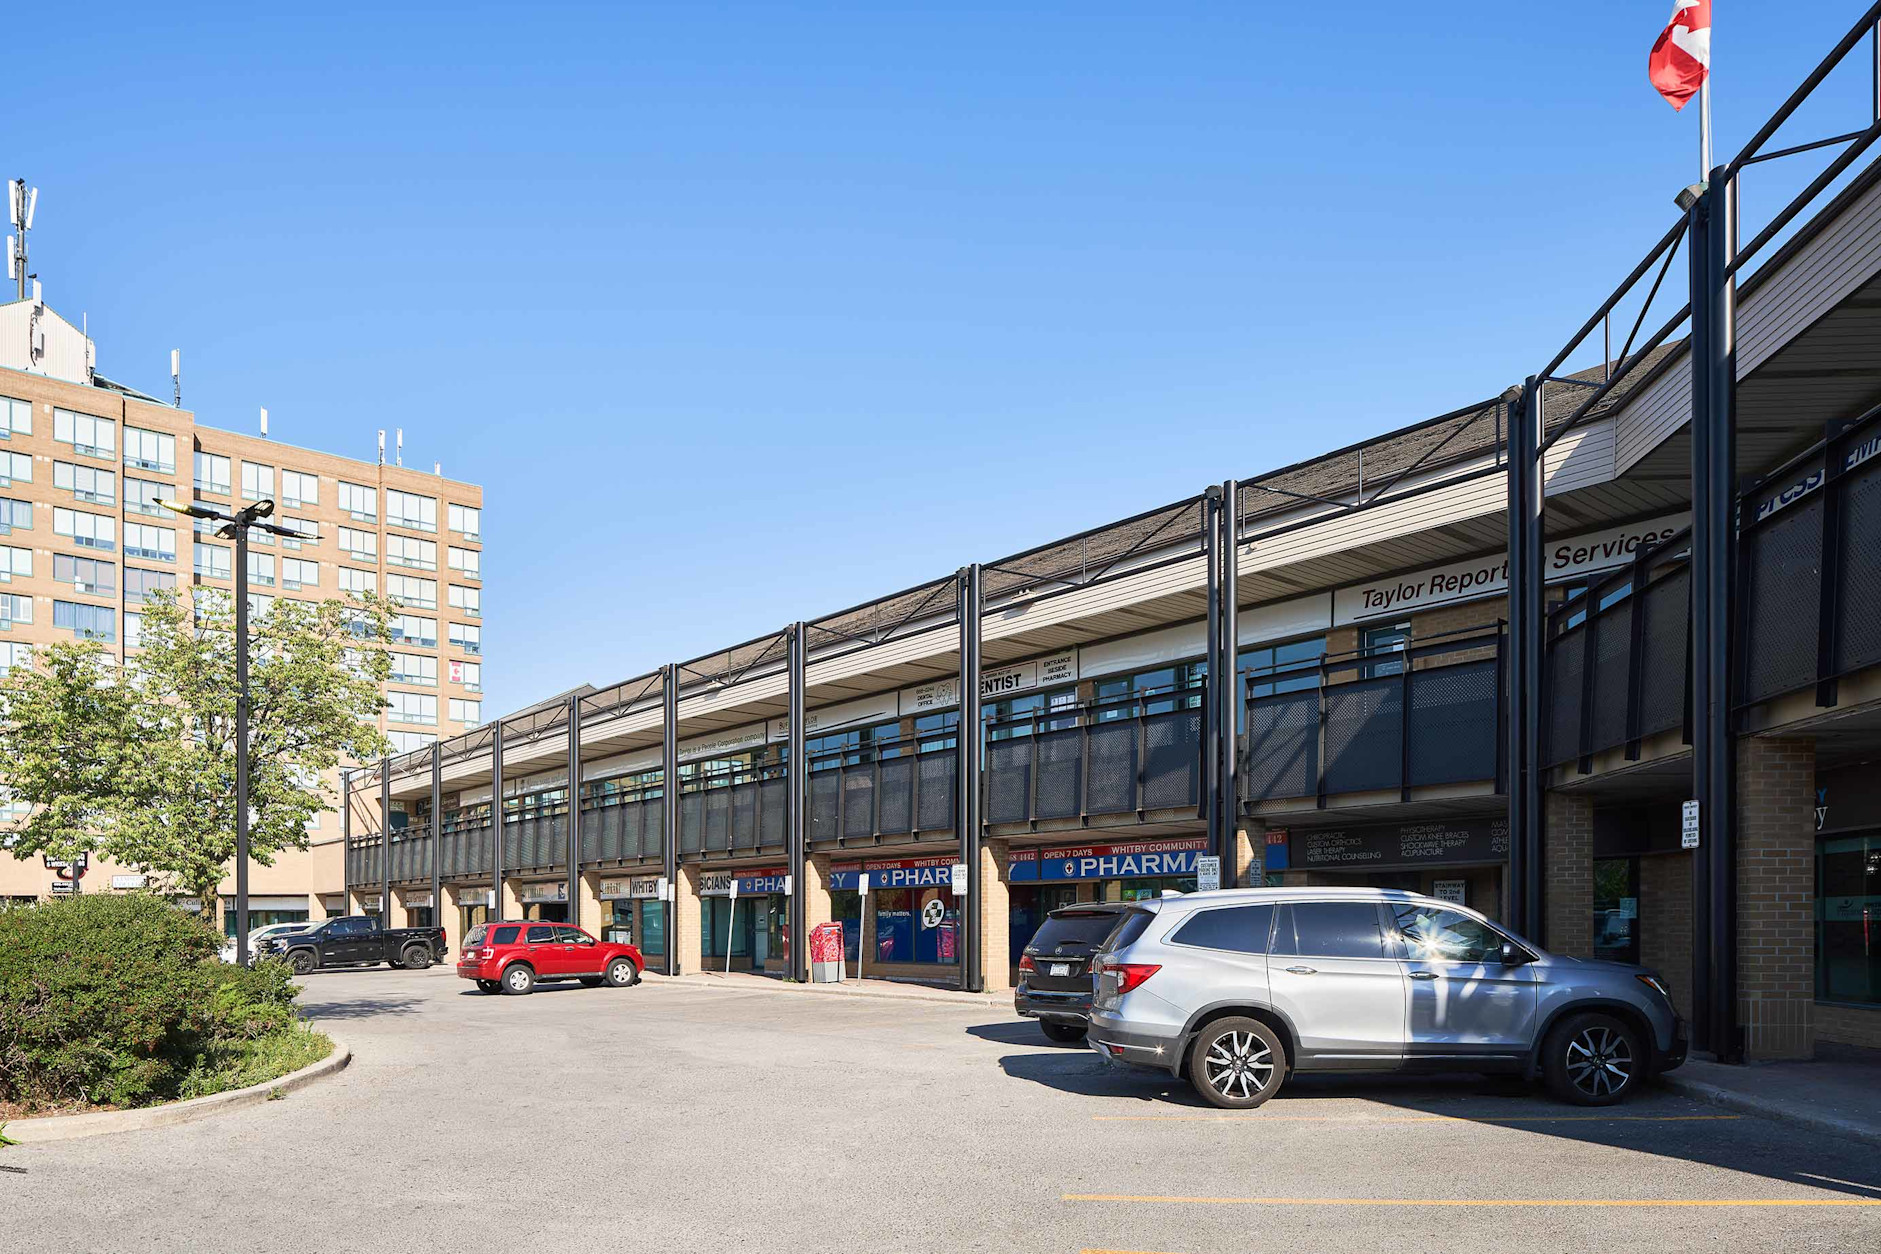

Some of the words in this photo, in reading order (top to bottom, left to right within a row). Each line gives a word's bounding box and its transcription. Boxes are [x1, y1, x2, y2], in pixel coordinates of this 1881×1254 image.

[1362, 581, 1425, 609] Taylor
[1429, 560, 1509, 597] Report
[1043, 656, 1072, 668] ENTRANCE
[1047, 664, 1067, 674] BESIDE
[1042, 671, 1072, 683] PHARMACY
[980, 673, 1022, 694] ENTIST
[717, 736, 744, 748] Corporation
[744, 732, 766, 742] company
[1400, 833, 1427, 842] CUSTOM
[1427, 832, 1444, 840] KNEE
[1444, 831, 1470, 839] BRACES
[1306, 840, 1331, 849] CUSTOM
[1331, 838, 1363, 847] ORTHOTICS
[1400, 841, 1439, 850] SHOCKWAVE
[1440, 839, 1466, 848] THERAPY
[1044, 850, 1066, 860] OPEN
[1066, 850, 1071, 858] 7
[1073, 848, 1093, 857] DAYS
[1111, 843, 1147, 854] WHITBY
[1149, 840, 1208, 852] COMMUNITY
[1323, 846, 1346, 855] THERAPY
[1400, 848, 1444, 857] ACUPUNCTURE
[1080, 851, 1205, 877] PHARMA
[1306, 853, 1341, 863] NUTRITIONAL
[866, 863, 882, 871] OPEN
[886, 862, 902, 870] DAYS
[914, 859, 940, 867] WHITBY
[700, 874, 732, 890] SICIANS
[892, 867, 950, 886] PHAR
[632, 880, 658, 894] WHITBY
